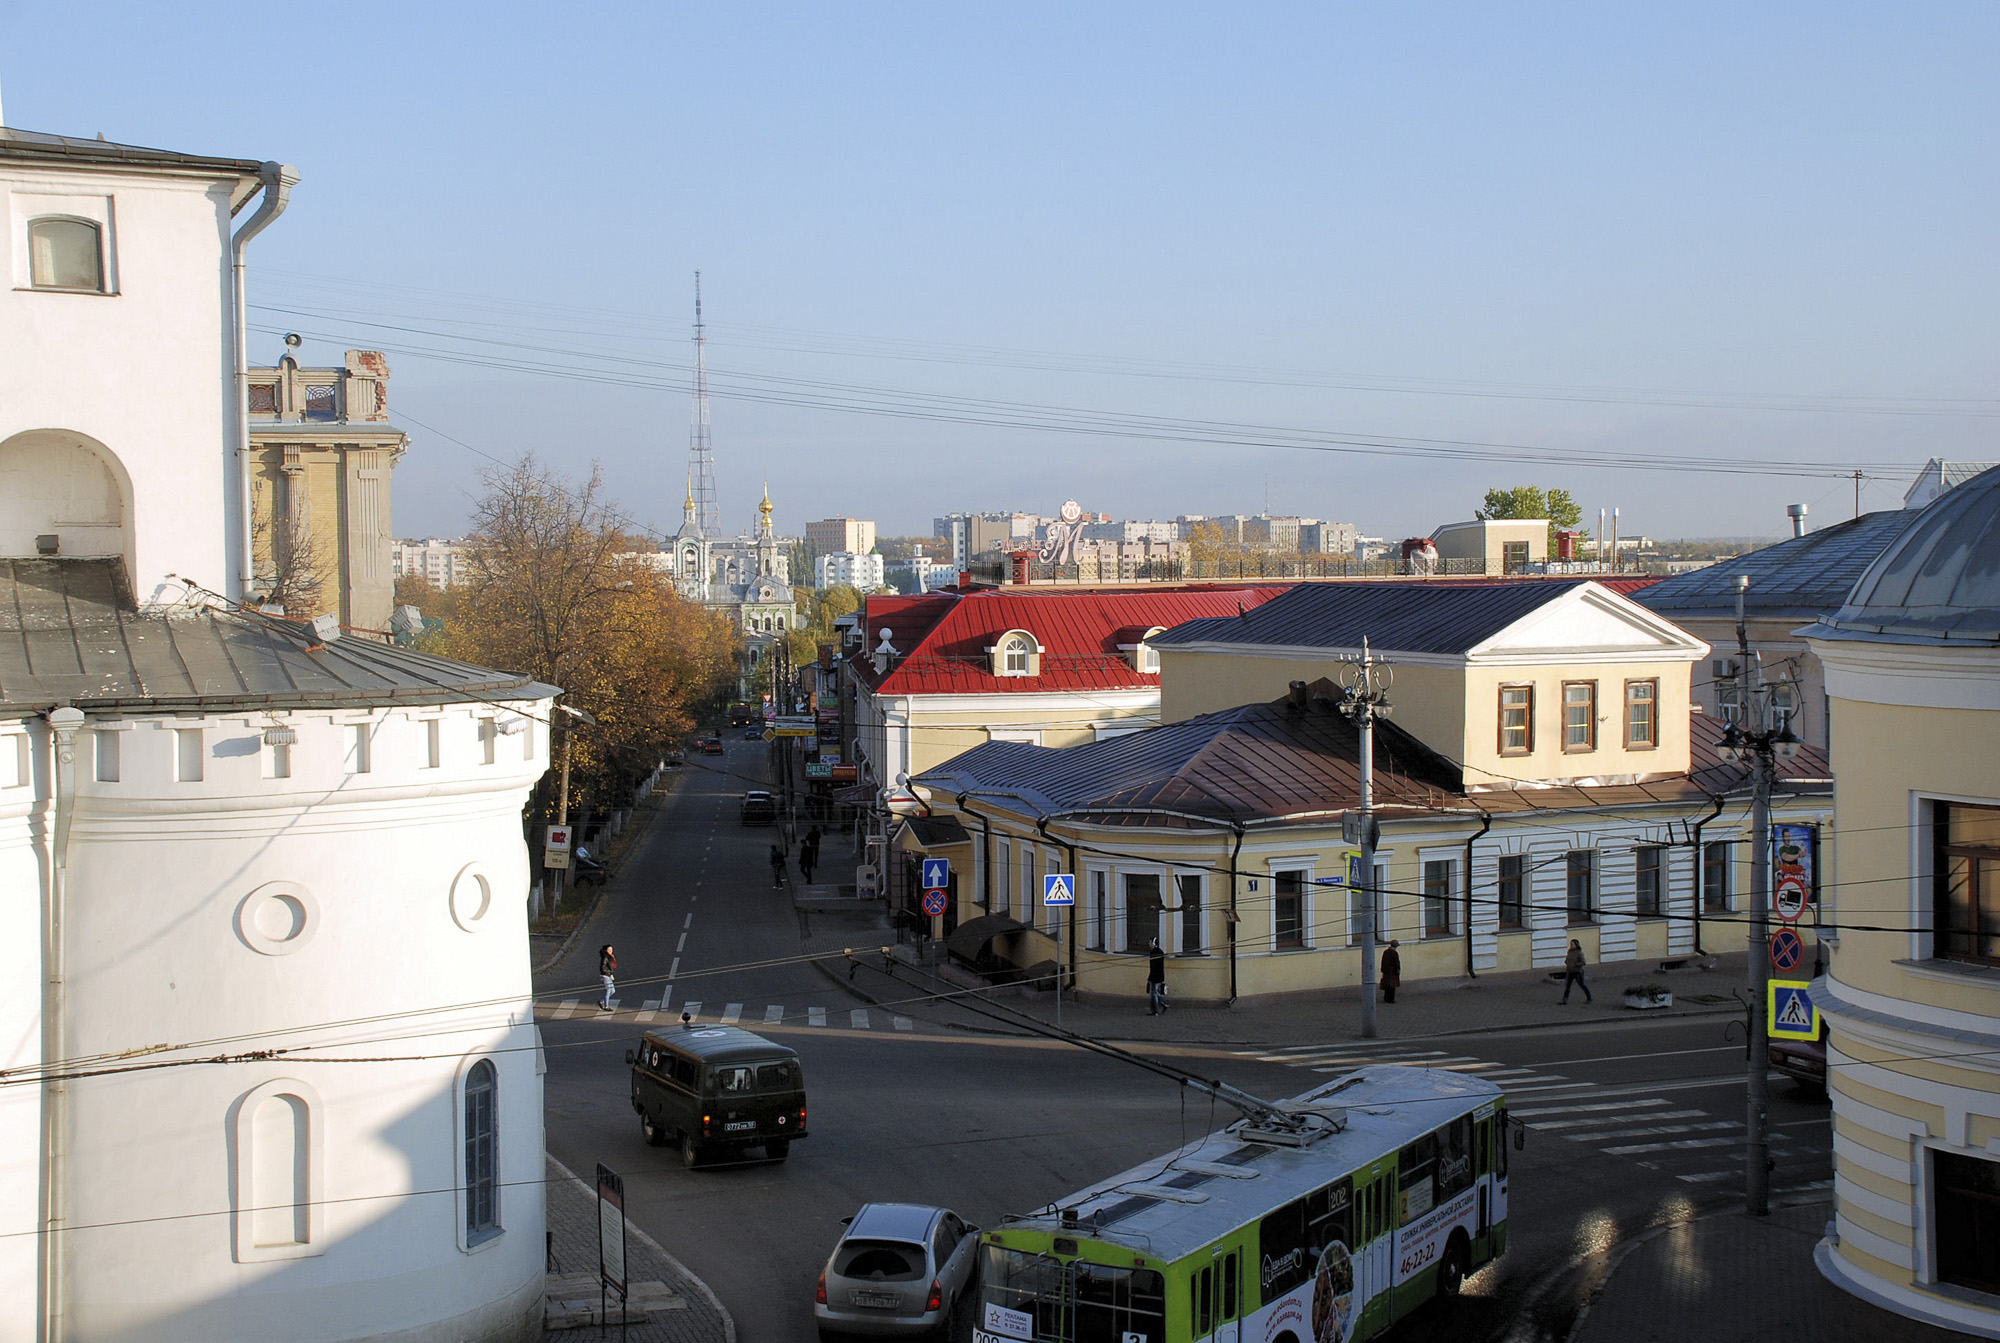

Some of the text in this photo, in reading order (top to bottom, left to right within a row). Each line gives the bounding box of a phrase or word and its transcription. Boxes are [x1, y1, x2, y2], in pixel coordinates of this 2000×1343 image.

[807, 765, 831, 773] ЦВЕТЫ
[1330, 1186, 1347, 1209] 202
[1401, 1198, 1408, 1214] 2
[1401, 1226, 1419, 1243] СЛУЖБА
[1418, 1206, 1454, 1233] УНИВЕРСАЛЬНОЙ
[1453, 1193, 1475, 1212] ДОСТАВКИ
[1400, 1241, 1435, 1276] 46-22-22
[1004, 1311, 1027, 1322] РЕКЛАМА
